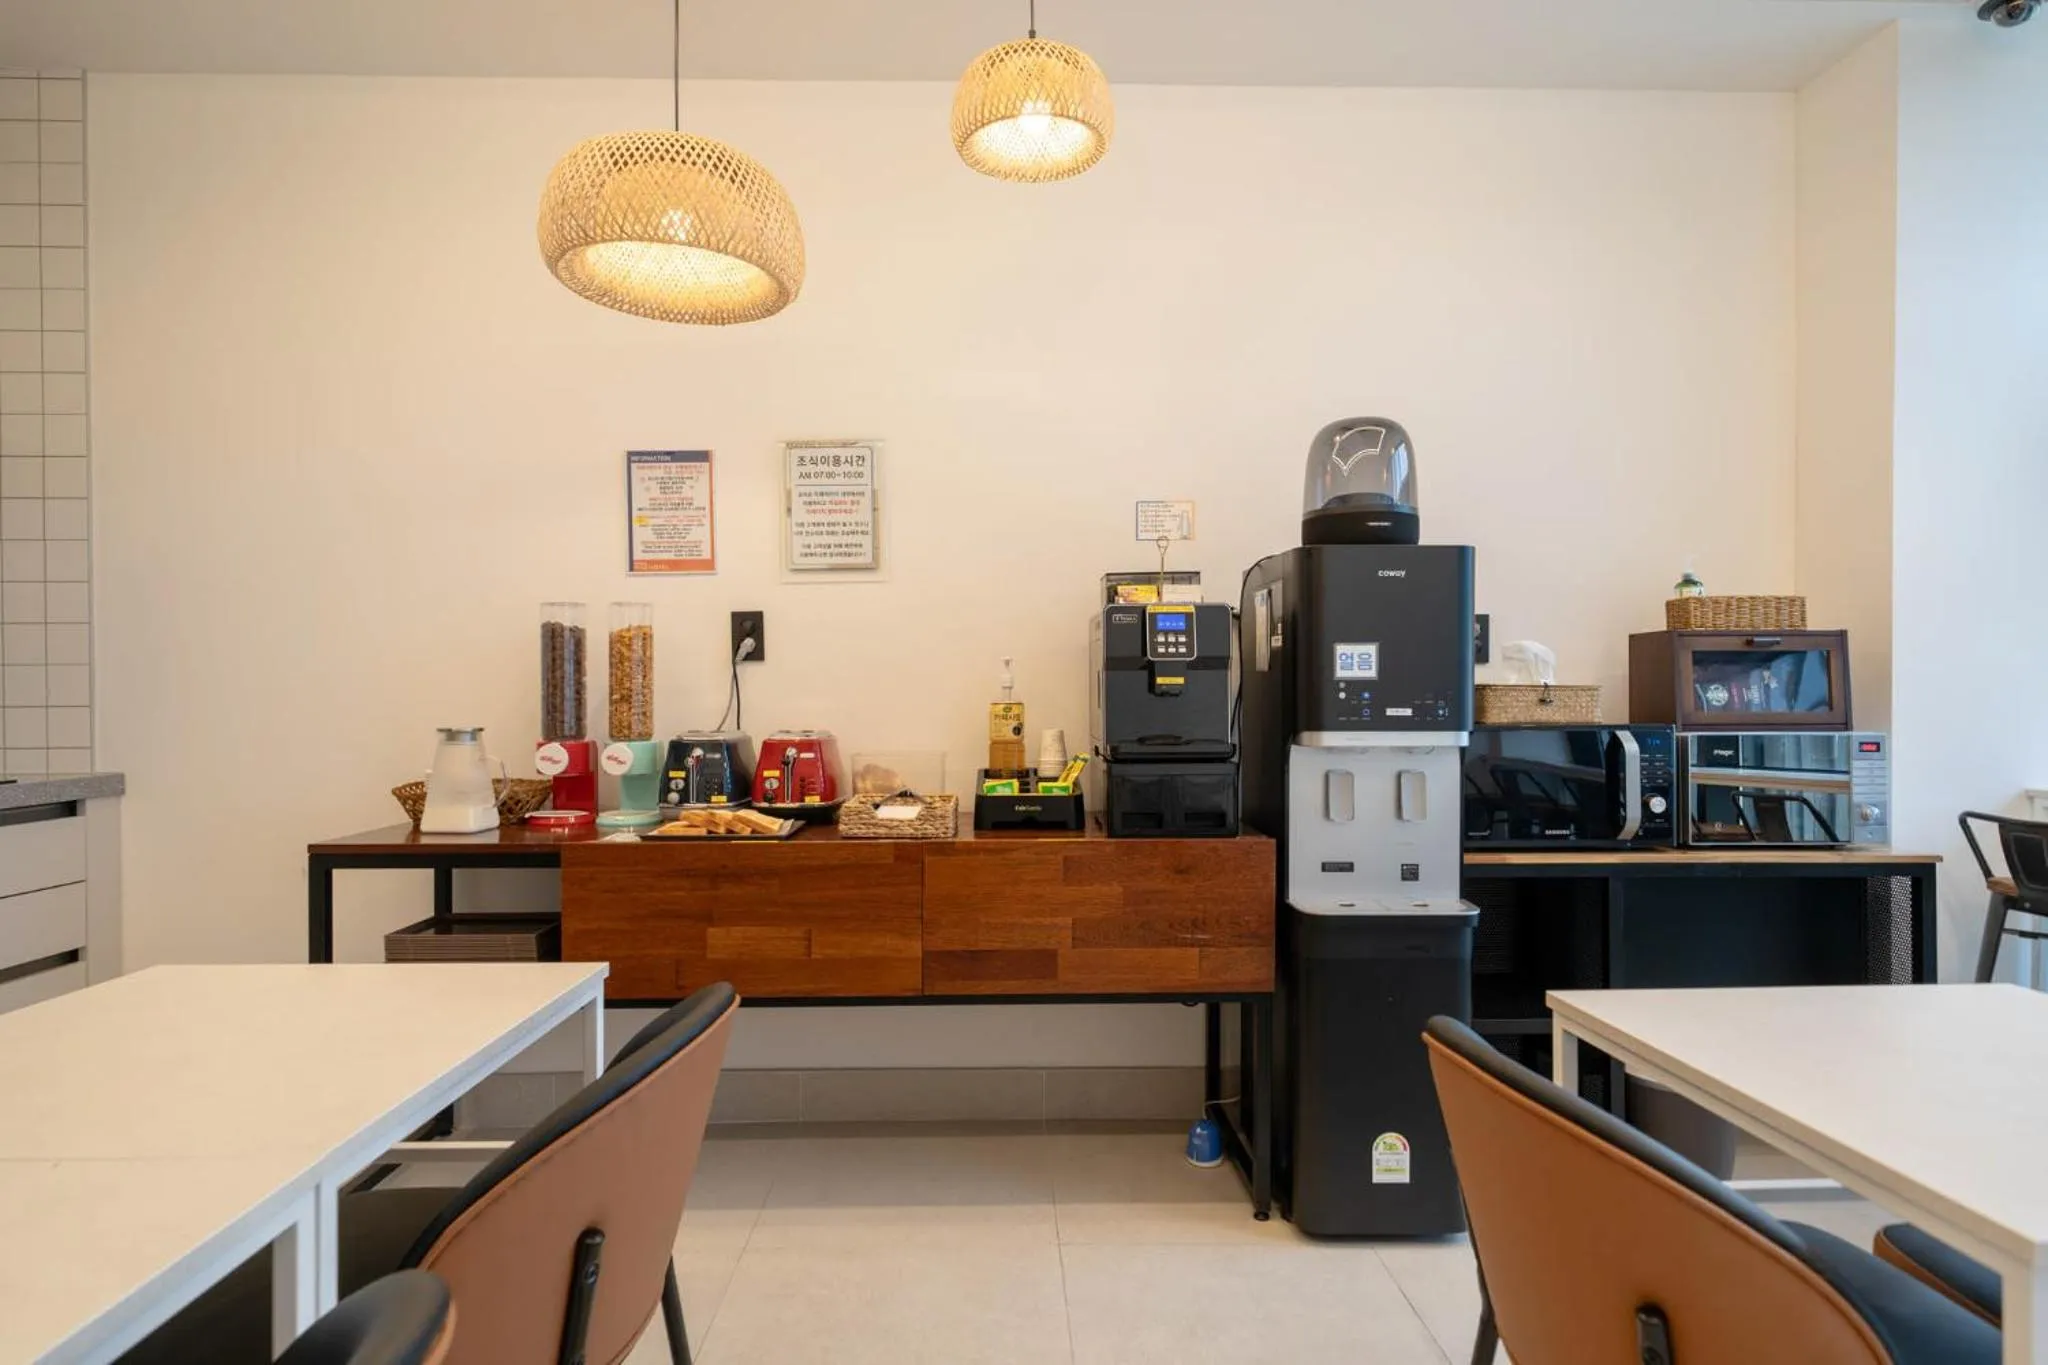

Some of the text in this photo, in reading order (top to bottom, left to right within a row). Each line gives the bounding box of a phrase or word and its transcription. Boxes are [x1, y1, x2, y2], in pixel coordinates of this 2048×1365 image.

[796, 454, 865, 467] 조식이용시간
[798, 471, 812, 479] AM
[1378, 569, 1406, 578] coway
[1339, 652, 1373, 671] 얼음
